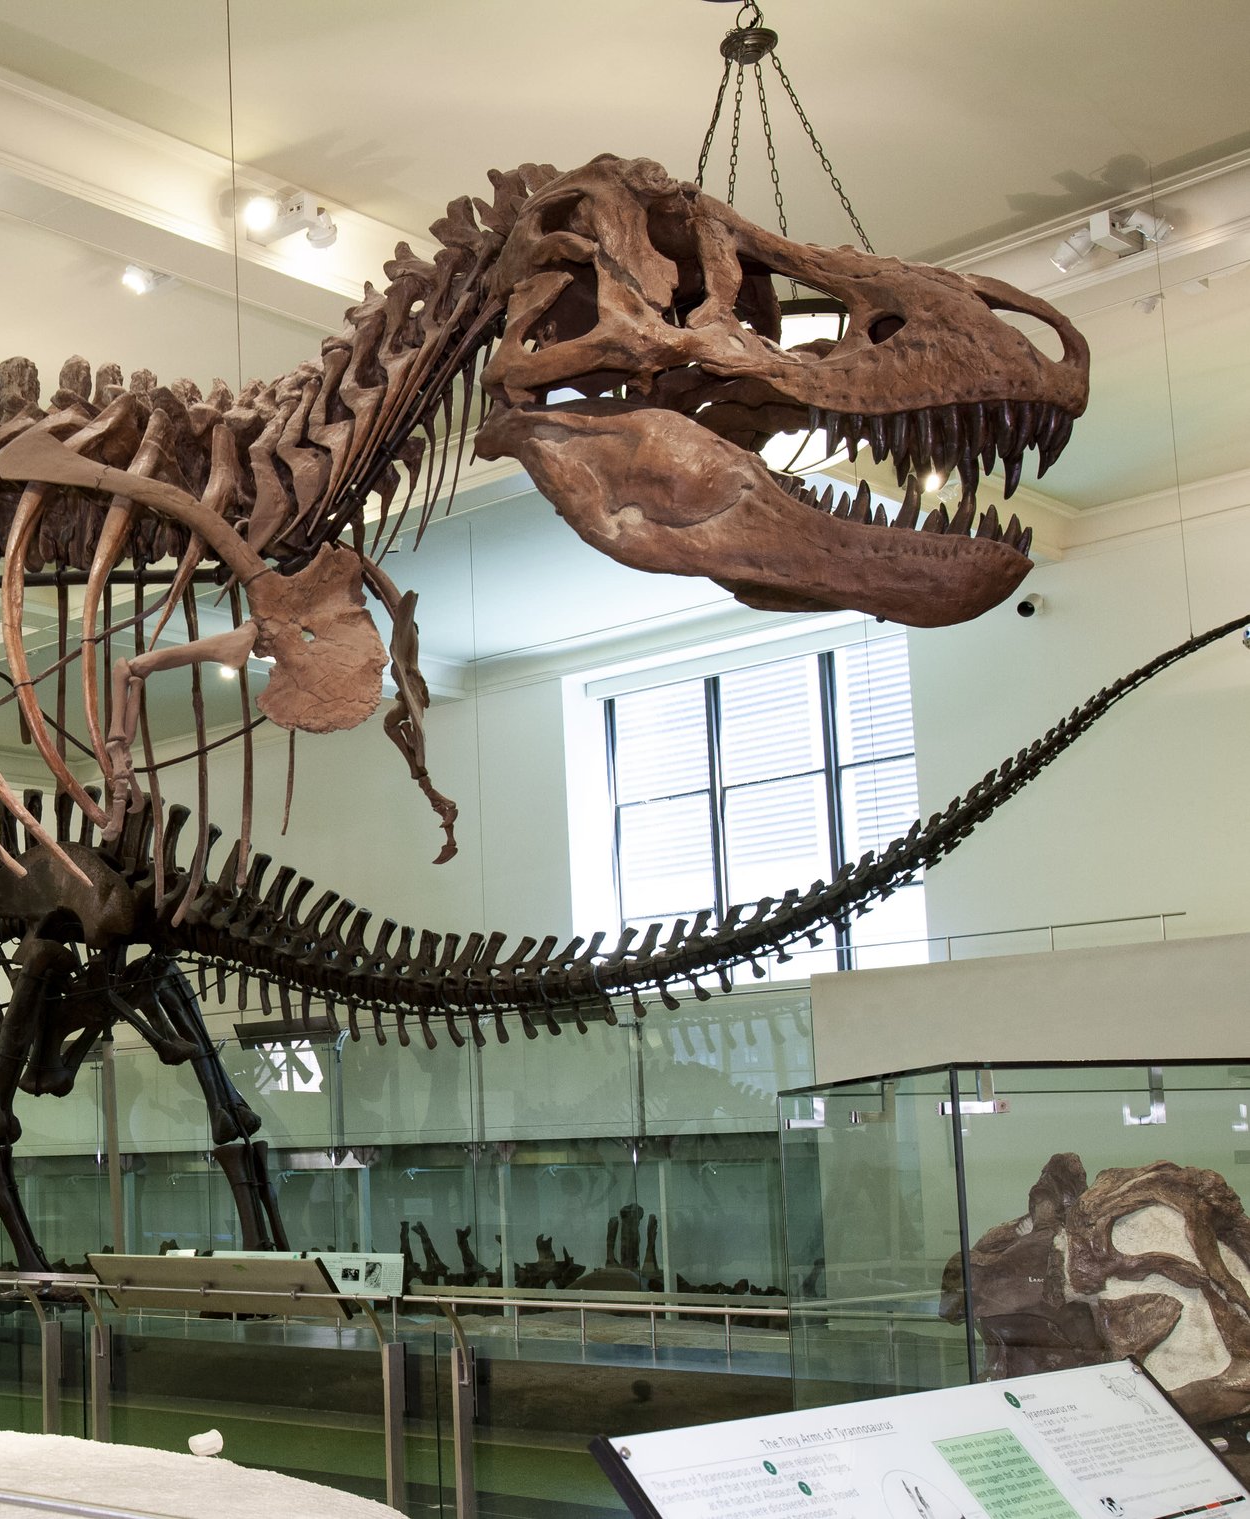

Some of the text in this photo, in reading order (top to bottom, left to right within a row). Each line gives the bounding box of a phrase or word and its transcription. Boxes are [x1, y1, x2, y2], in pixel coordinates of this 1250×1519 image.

[1022, 1406, 1068, 1421] Tyrannosaurus
[760, 1420, 894, 1450] The Tiny Arms of Tyrannosaurus
